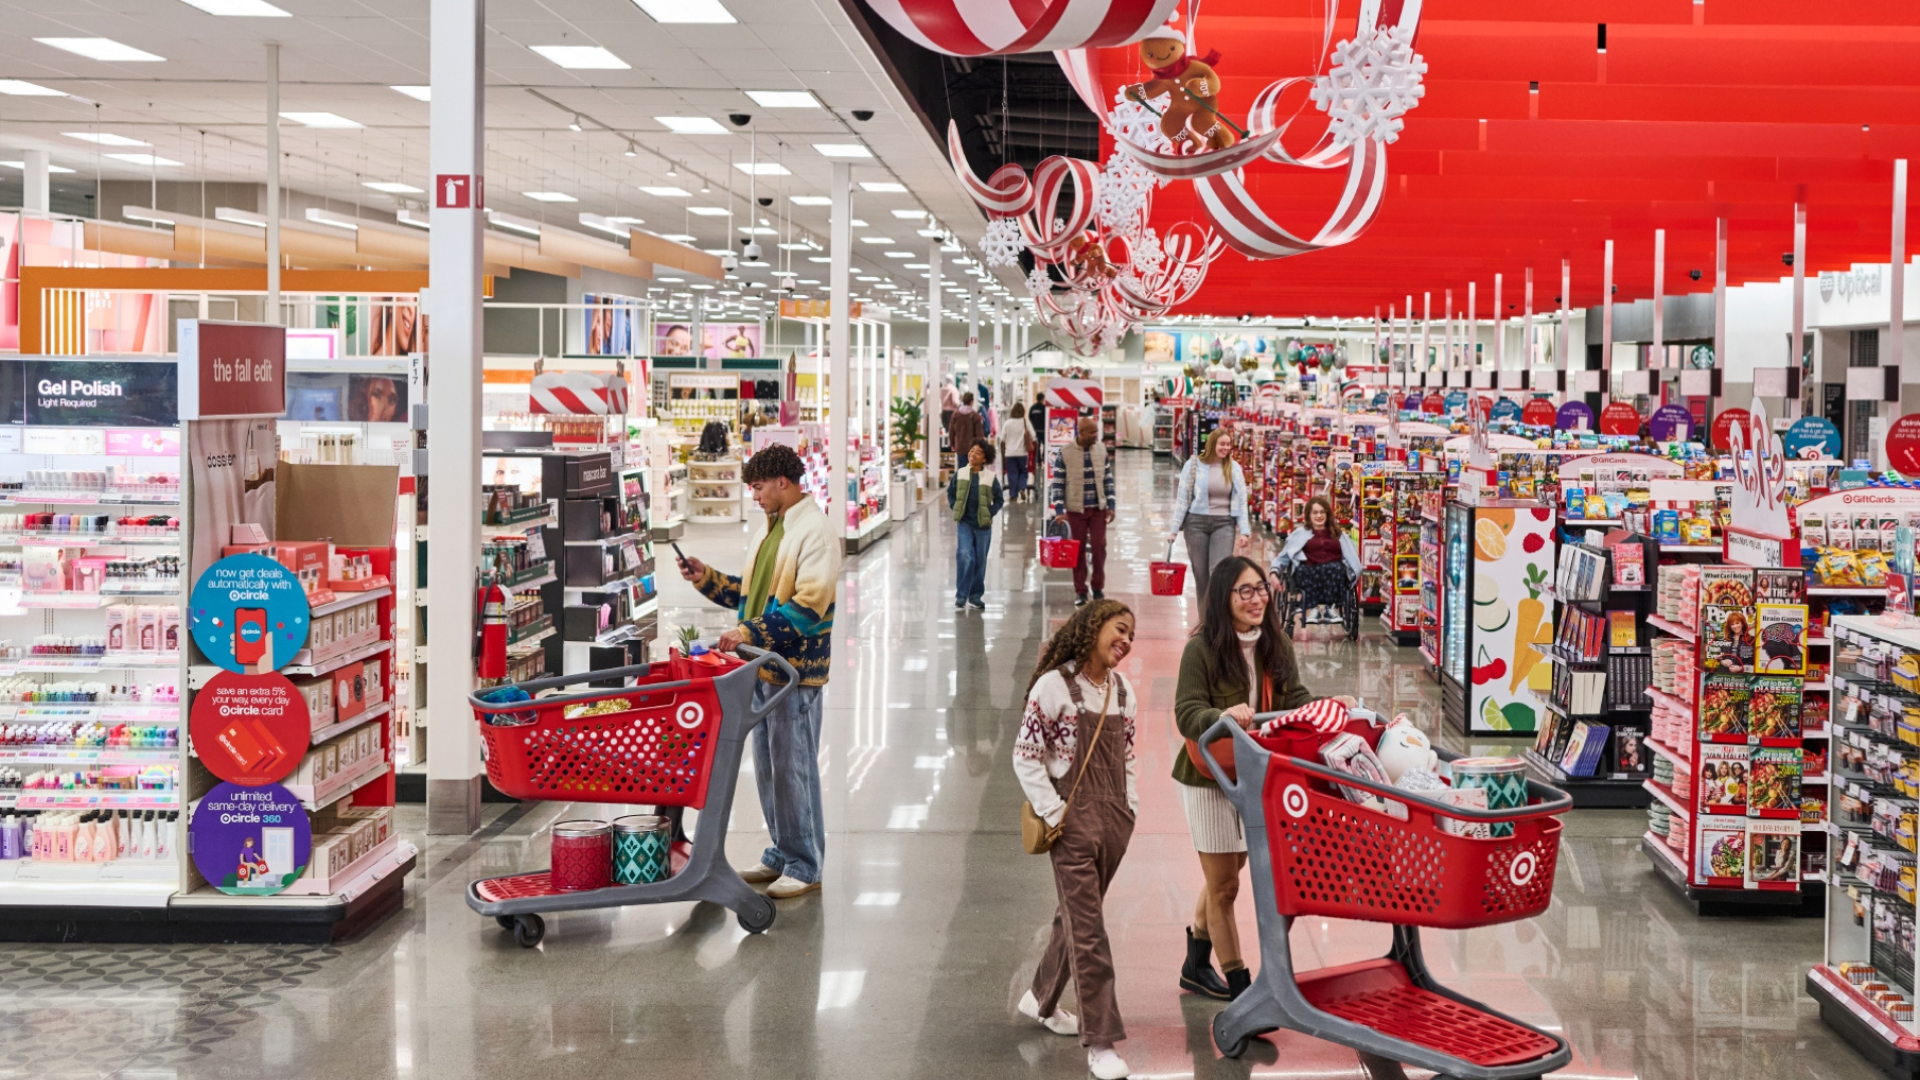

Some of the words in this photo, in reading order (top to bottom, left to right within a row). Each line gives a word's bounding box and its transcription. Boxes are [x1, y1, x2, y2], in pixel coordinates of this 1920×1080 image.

[1838, 266, 1882, 303] Optical
[213, 358, 232, 382] the
[235, 358, 251, 382] fall
[254, 359, 273, 382] edit
[38, 379, 66, 395] Gel
[71, 380, 122, 396] Polish
[38, 398, 57, 408] Light
[60, 398, 97, 408] Required
[207, 451, 237, 469] dossier
[583, 469, 600, 482] mascara
[1853, 494, 1896, 504] GiftCards
[216, 569, 237, 578] now
[239, 569, 255, 580] get
[257, 568, 283, 578] deals
[208, 579, 269, 591] automatically
[271, 580, 292, 590] with
[240, 590, 269, 600] circle
[1772, 588, 1788, 597] THE
[1708, 682, 1749, 690] DIABETES
[1754, 686, 1797, 694] DIABETES
[216, 687, 236, 695] save
[237, 687, 248, 695] an
[250, 687, 270, 695] extra
[272, 687, 286, 696] 5%
[212, 697, 230, 705] your
[231, 697, 249, 705] way,
[250, 697, 273, 706] every
[275, 696, 290, 706] day
[230, 705, 260, 715] circle
[261, 706, 284, 716] card
[230, 791, 272, 801] unlimited
[207, 802, 256, 813] same-day
[231, 813, 261, 823] circle
[262, 814, 282, 823] 360
